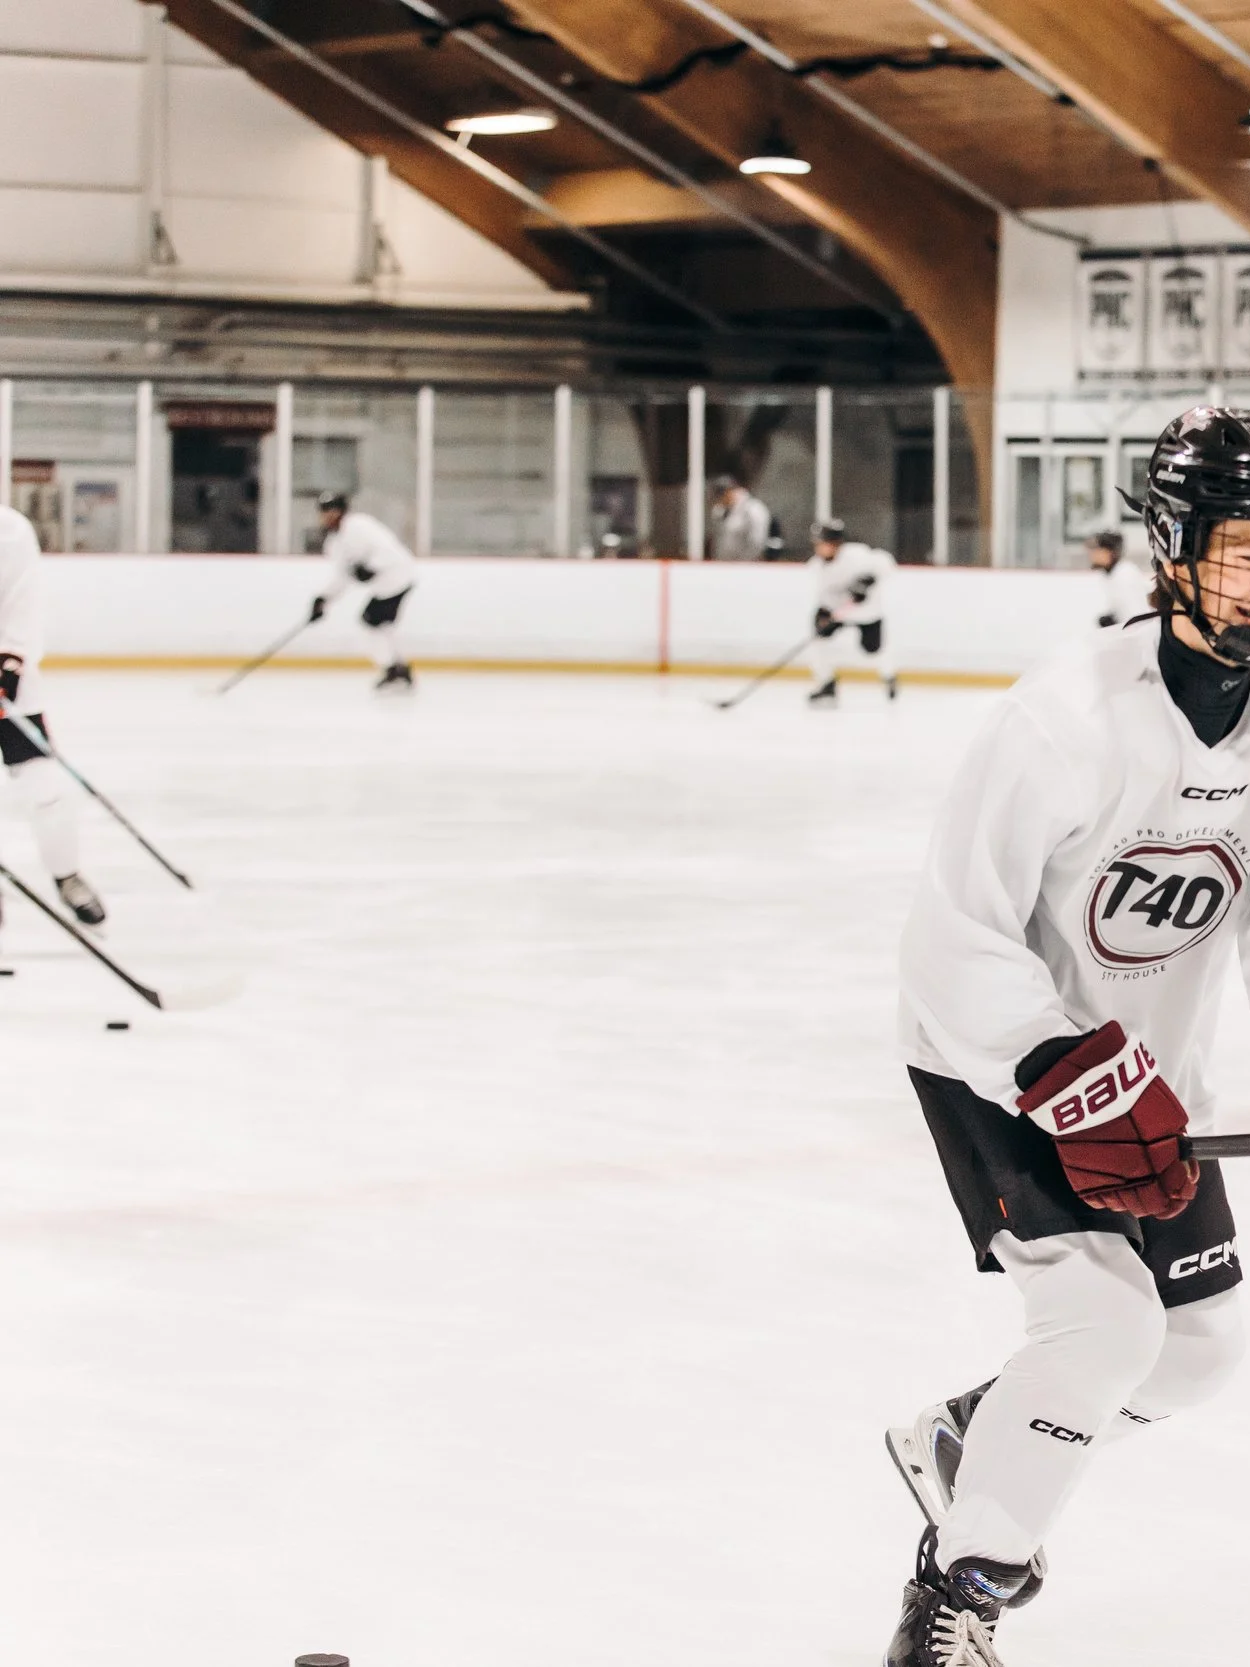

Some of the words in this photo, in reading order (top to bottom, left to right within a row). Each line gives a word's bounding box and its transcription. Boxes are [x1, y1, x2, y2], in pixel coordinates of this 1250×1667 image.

[1181, 784, 1248, 801] CCM
[1136, 828, 1165, 839] PRO
[1101, 861, 1225, 930] T40
[1122, 963, 1167, 981] HOUSE
[1168, 1236, 1238, 1279] CCM
[1029, 1418, 1095, 1447] CCM
